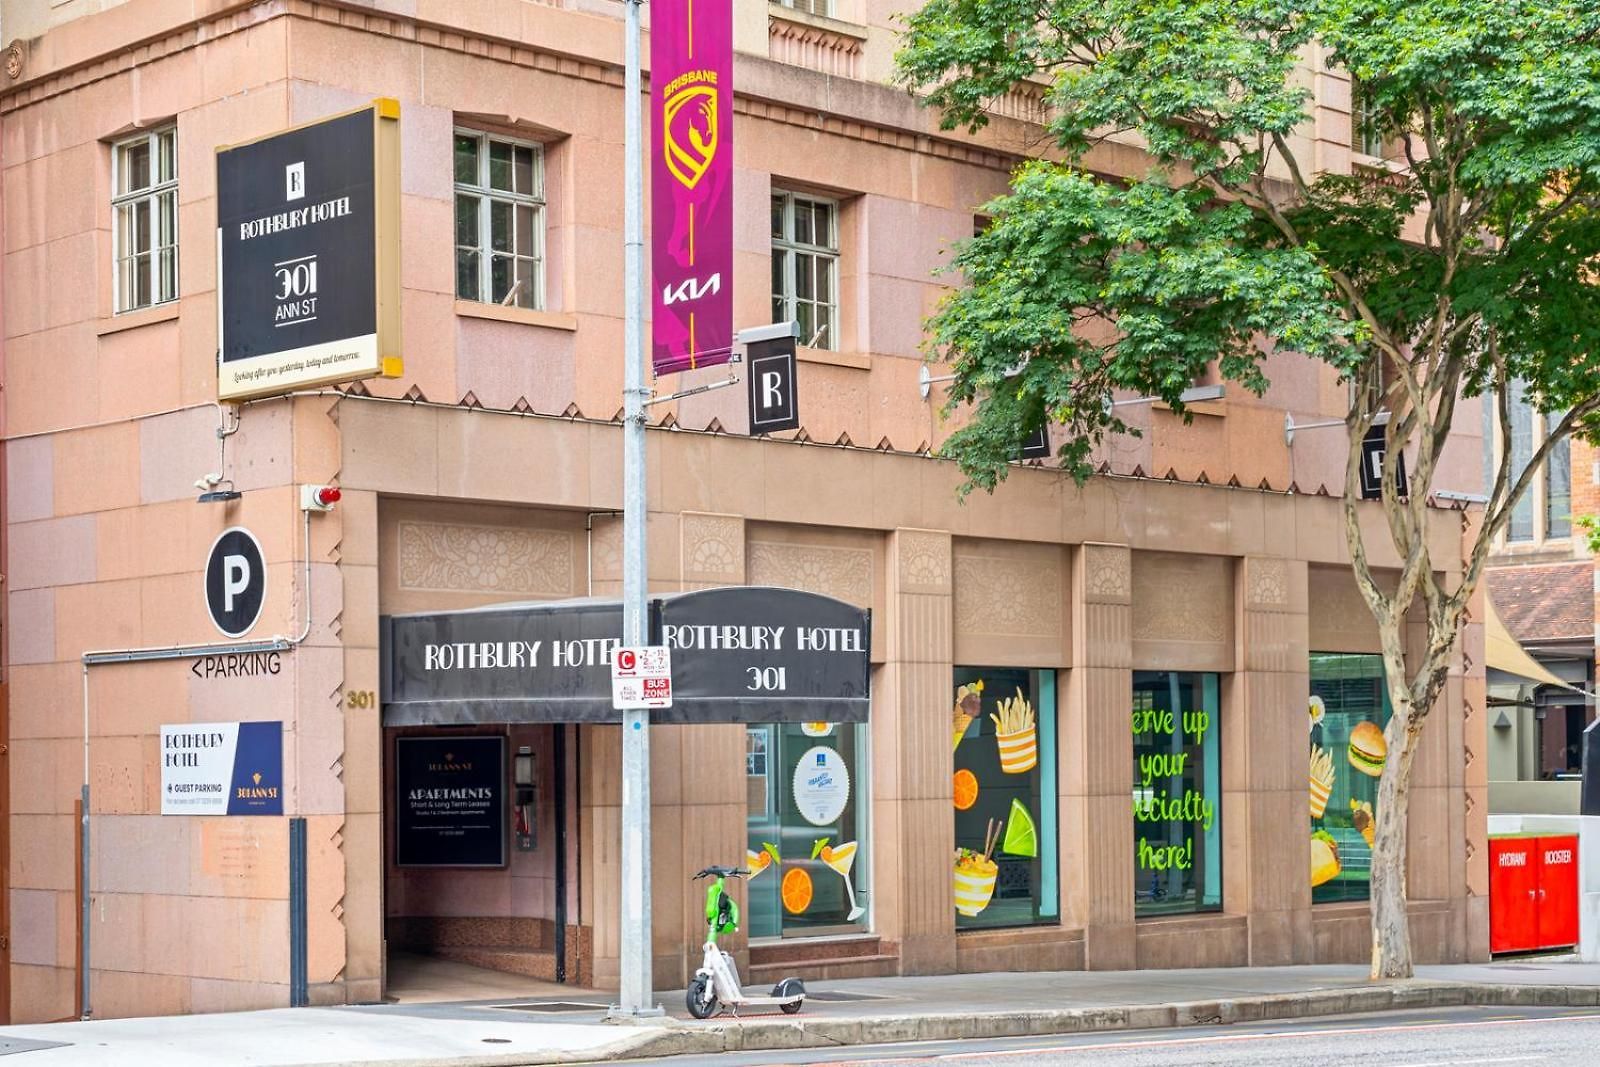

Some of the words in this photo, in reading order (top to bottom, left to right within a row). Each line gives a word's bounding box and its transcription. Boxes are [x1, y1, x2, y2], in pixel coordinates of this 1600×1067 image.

[664, 69, 718, 100] BRISBANE
[240, 206, 310, 240] ROTHBURY
[311, 196, 352, 224] HOTEL
[275, 261, 317, 300] 301
[663, 272, 721, 306] KIA
[275, 301, 300, 321] ANN
[302, 297, 317, 316] ST
[322, 353, 333, 364] and
[762, 371, 782, 409] R
[223, 554, 250, 612] P
[662, 624, 785, 650] ROTHBURY
[797, 626, 866, 652] HOTEL
[425, 640, 542, 670] ROTHBURY
[621, 652, 633, 668] C
[648, 679, 666, 688] BUS
[747, 666, 786, 691] 301
[347, 690, 375, 709] 301
[645, 689, 669, 698] ZONE
[1183, 710, 1209, 745] up
[166, 733, 224, 749] ROTHBURY
[166, 752, 200, 768] HOTEL
[1140, 753, 1188, 786] your
[174, 783, 194, 793] GUEST
[195, 783, 222, 793] PARKING
[408, 788, 492, 800] APARTMENTS
[1137, 837, 1192, 871] here!
[1498, 852, 1527, 867] HYDRANT
[1544, 849, 1572, 865] BOOSTER
